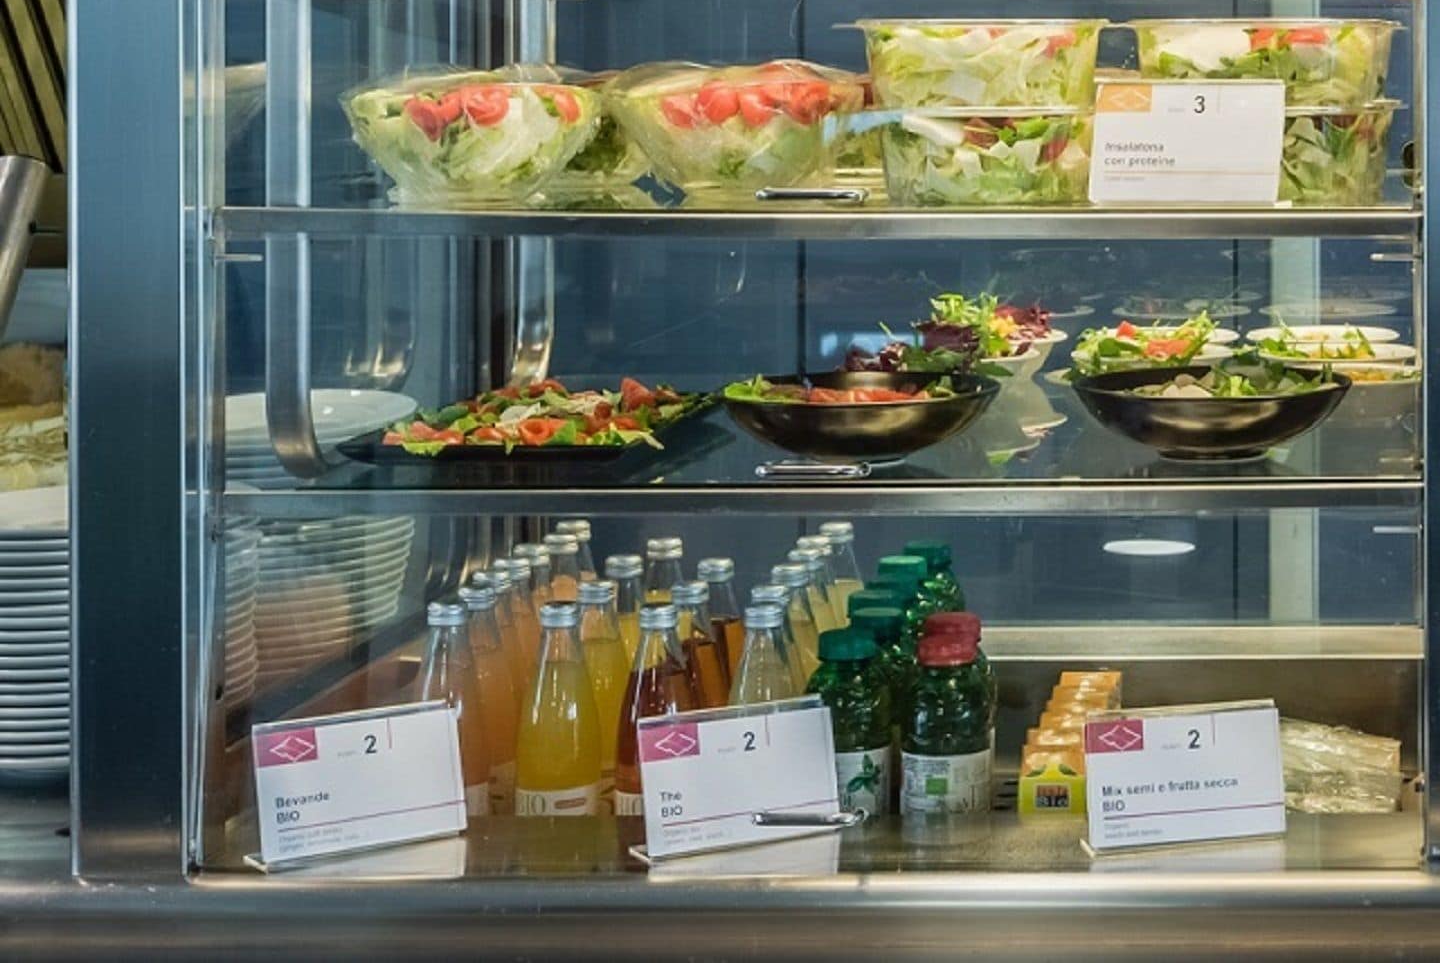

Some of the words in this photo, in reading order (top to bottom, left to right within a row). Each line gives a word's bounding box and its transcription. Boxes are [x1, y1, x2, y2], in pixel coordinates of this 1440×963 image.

[1194, 96, 1205, 113] 3
[1104, 157, 1125, 165] con
[1129, 155, 1175, 167] proteine
[364, 735, 377, 754] 2
[743, 732, 755, 751] 2
[1188, 730, 1200, 749] 2
[1102, 786, 1122, 797] Mix
[1127, 784, 1155, 795] semi
[1169, 780, 1199, 791] frutta
[1204, 778, 1238, 789] secca
[275, 791, 330, 808] Bevande
[1102, 799, 1125, 812] BIO
[276, 810, 300, 824] BIO
[661, 806, 682, 817] BIO
